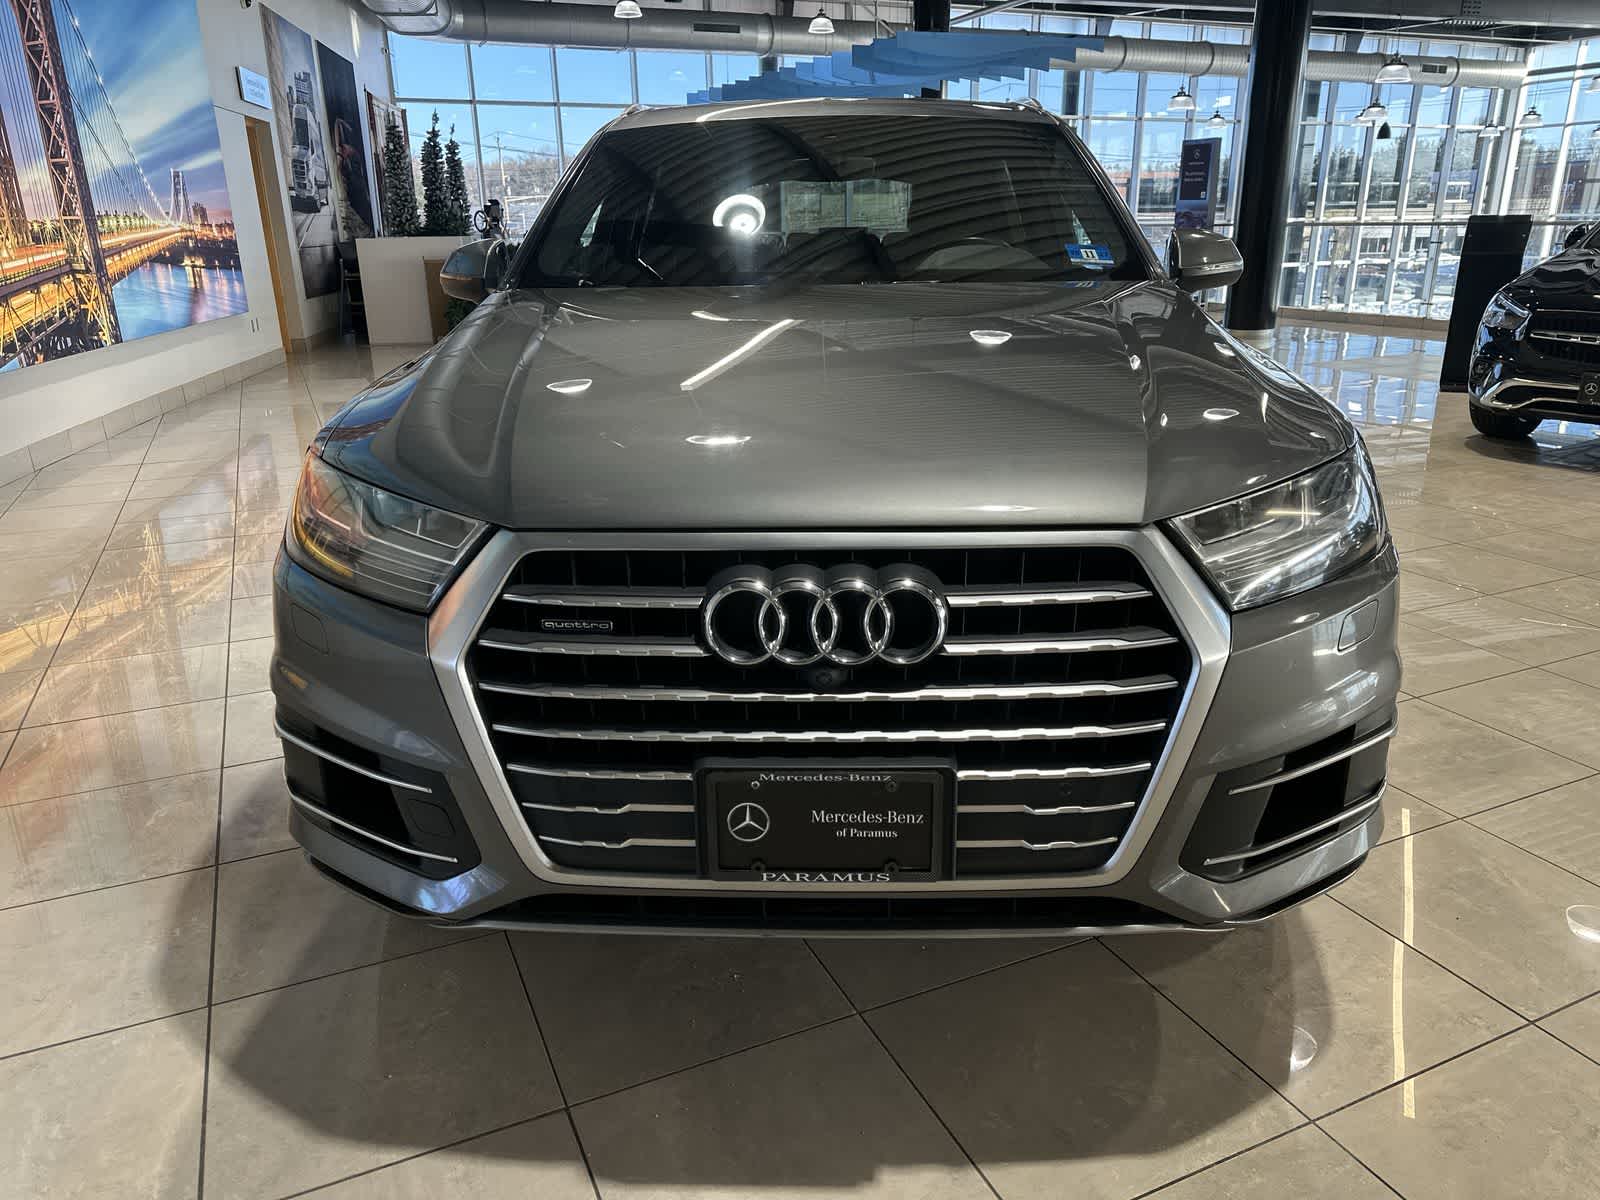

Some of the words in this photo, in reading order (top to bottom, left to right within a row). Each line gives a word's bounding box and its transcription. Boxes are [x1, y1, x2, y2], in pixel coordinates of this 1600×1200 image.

[759, 773, 893, 782] Mercedes-Benz
[811, 810, 924, 824] Mercedes-Benz
[836, 828, 847, 838] of
[850, 828, 898, 838] Paramus
[761, 872, 891, 882] PARAMUS
